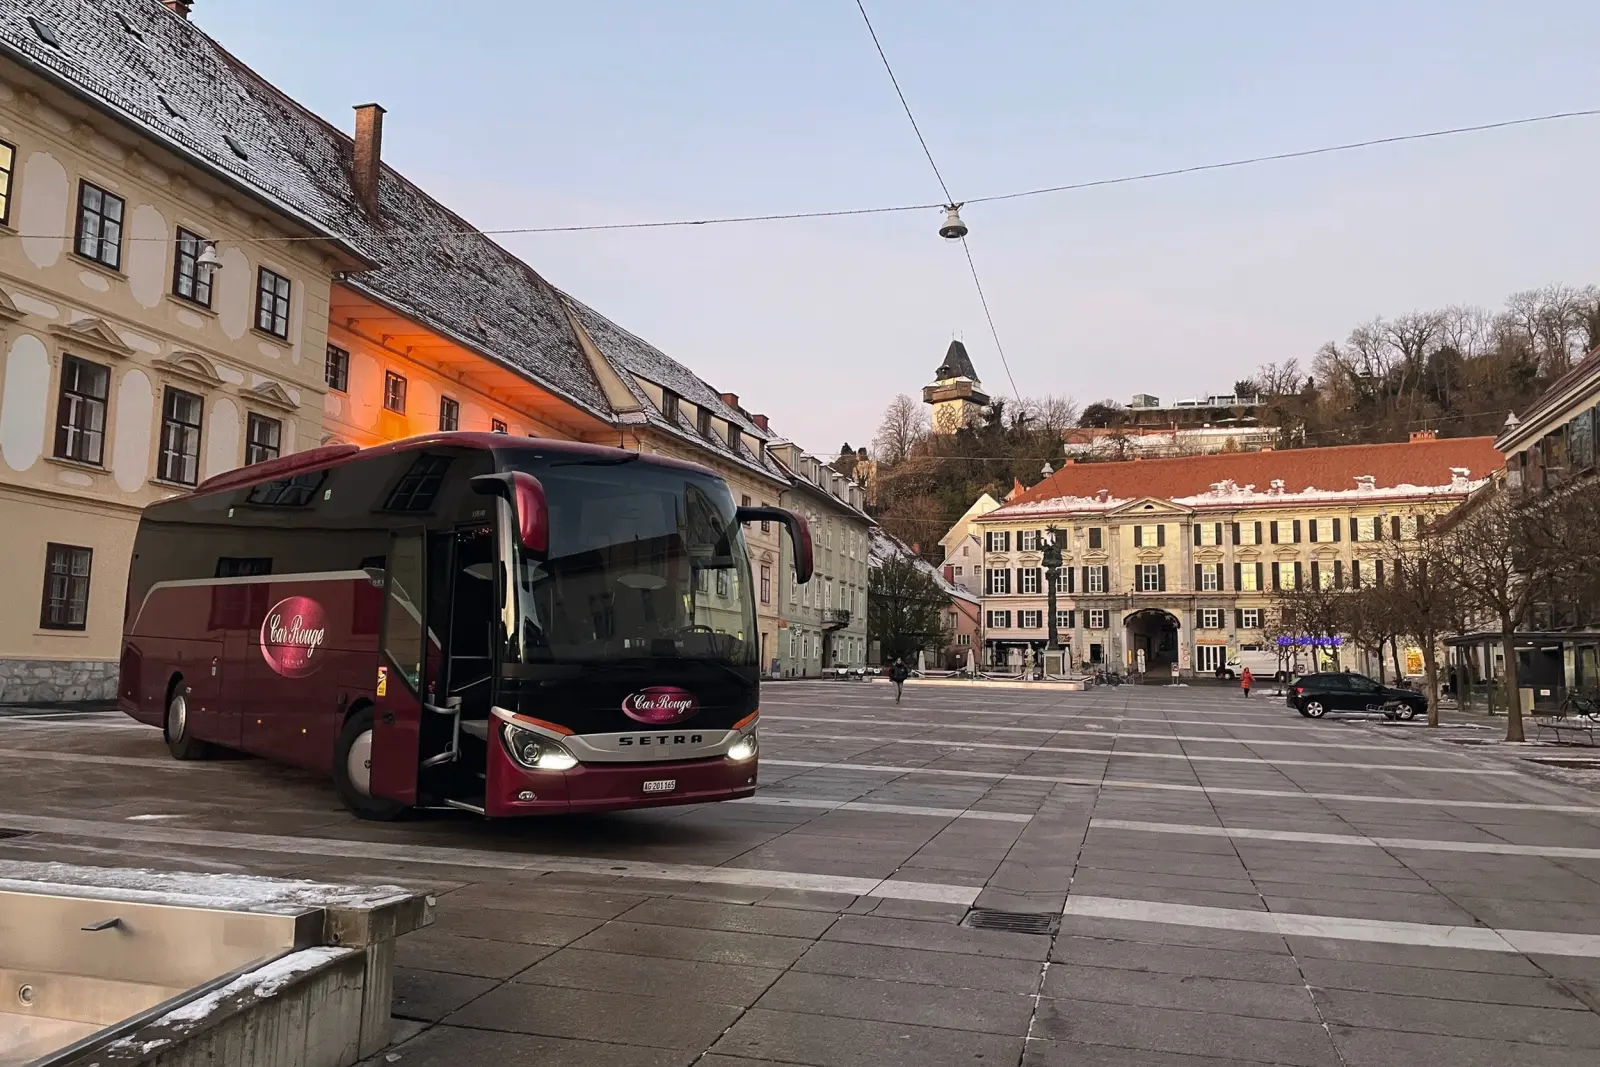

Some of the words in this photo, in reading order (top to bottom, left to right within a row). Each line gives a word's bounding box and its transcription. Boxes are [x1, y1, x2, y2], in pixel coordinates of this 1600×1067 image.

[269, 613, 287, 643] Car
[288, 614, 325, 659] Rouge
[633, 693, 655, 710] Car
[655, 693, 693, 715] Rouge
[618, 734, 703, 746] SETRA
